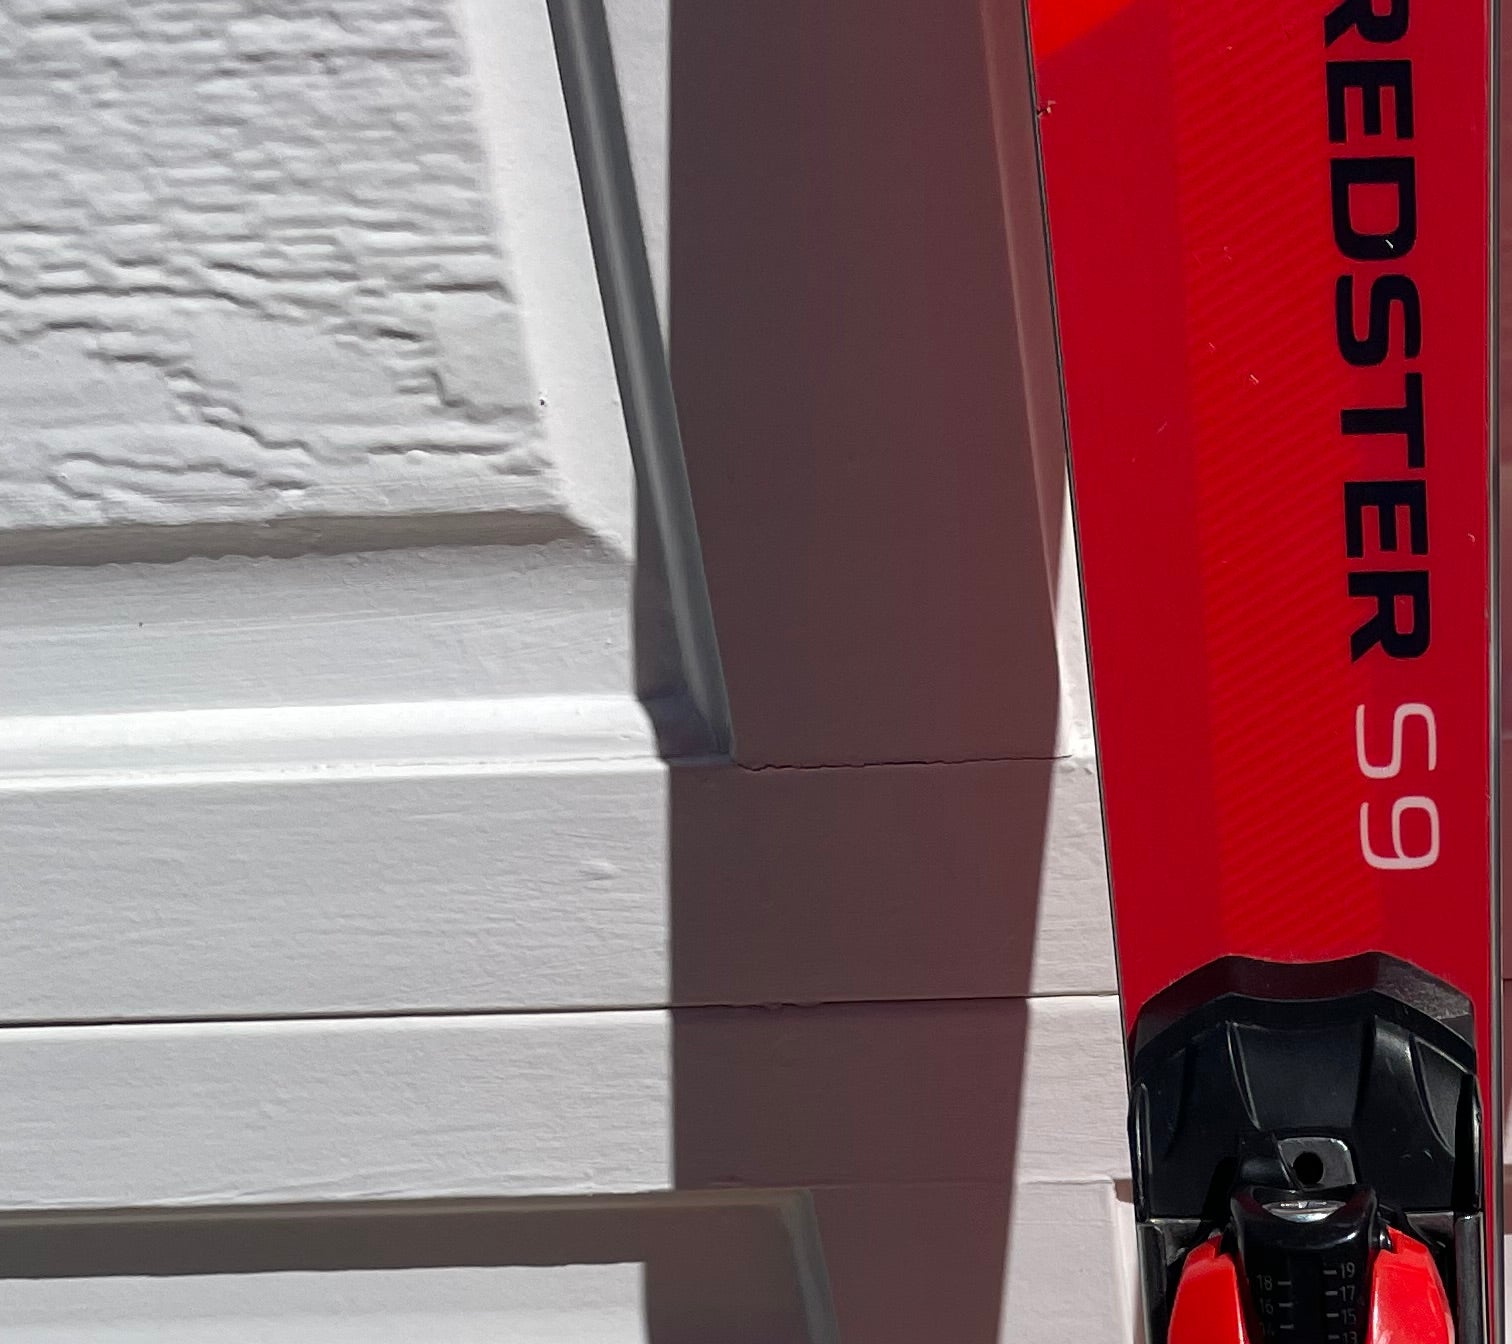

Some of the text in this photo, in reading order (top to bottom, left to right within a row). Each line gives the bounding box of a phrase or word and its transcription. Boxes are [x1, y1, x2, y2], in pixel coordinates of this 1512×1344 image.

[1355, 702, 1440, 870] S9
[1341, 1262, 1355, 1279] 19
[1257, 1274, 1272, 1291] 18
[1340, 1285, 1355, 1302] 17
[1341, 1308, 1356, 1325] 15
